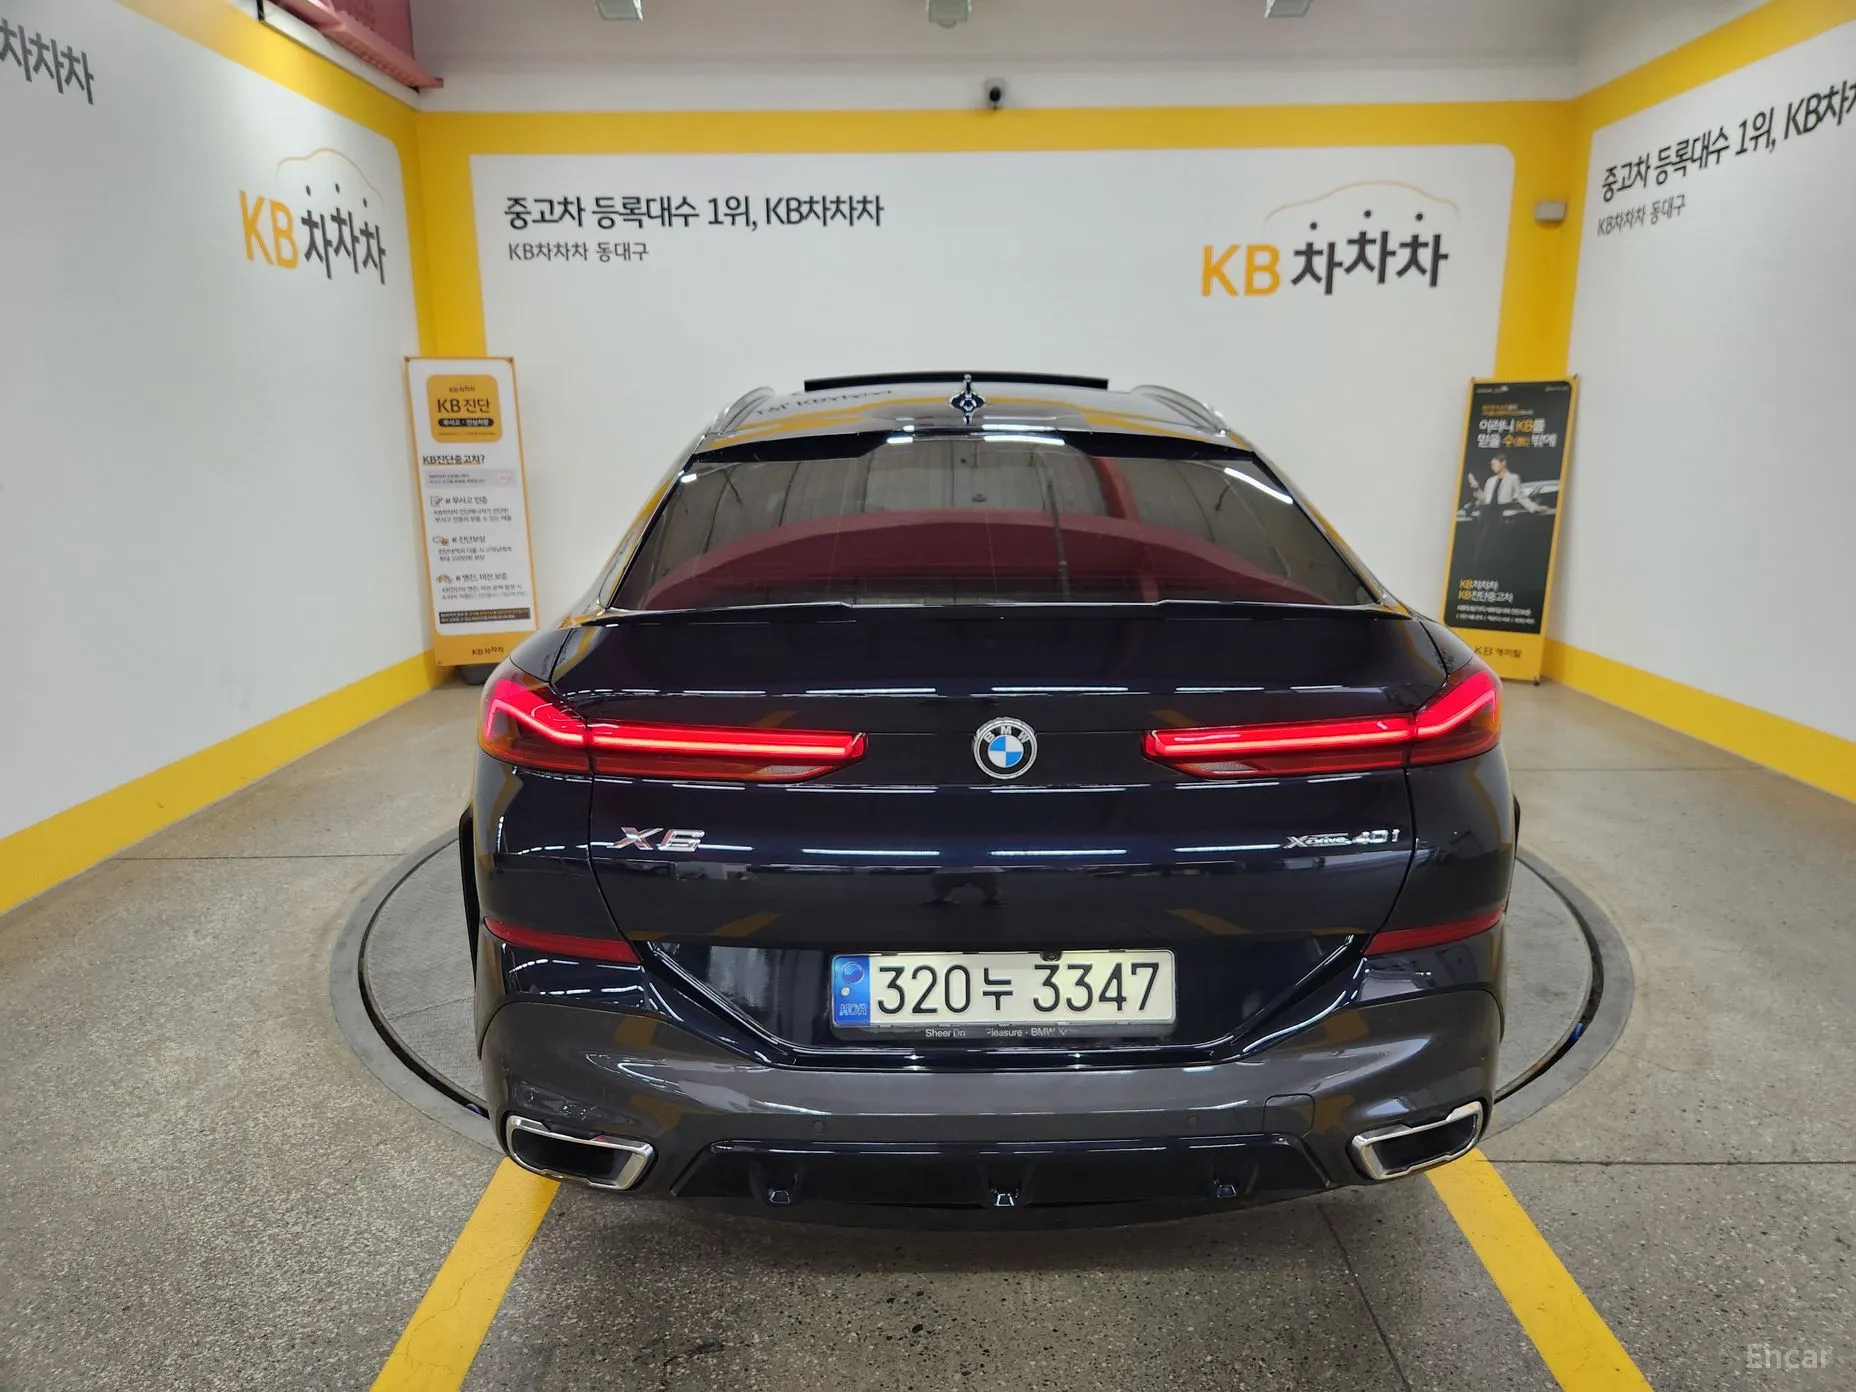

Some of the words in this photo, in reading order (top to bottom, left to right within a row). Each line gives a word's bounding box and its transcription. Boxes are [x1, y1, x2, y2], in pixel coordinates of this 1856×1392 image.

[1601, 152, 1651, 203] 중고차
[1654, 125, 1731, 187] 등록대수
[1735, 107, 1776, 153] 1위,
[504, 195, 586, 230] 중고차
[592, 195, 700, 230] 등록대수
[708, 195, 758, 232] 1위,
[766, 194, 885, 227] KB차차차
[1597, 203, 1646, 237] KB차차차
[1650, 193, 1687, 225] 동대구
[239, 189, 299, 270] KB
[301, 207, 387, 285] 차차차
[508, 241, 589, 262] KB차차차
[595, 241, 650, 263] 동대구
[1200, 243, 1281, 297] KB
[1290, 229, 1450, 296] 차차차
[436, 398, 462, 413] KB
[463, 397, 491, 413] 진단
[422, 453, 486, 466] KB진단중고차?
[983, 725, 1031, 744] BMW
[606, 826, 706, 852] X6
[877, 964, 1014, 1015] 320누
[1033, 961, 1160, 1014] 3347
[839, 1002, 868, 1016] KOR
[925, 1028, 951, 1038] Sheer
